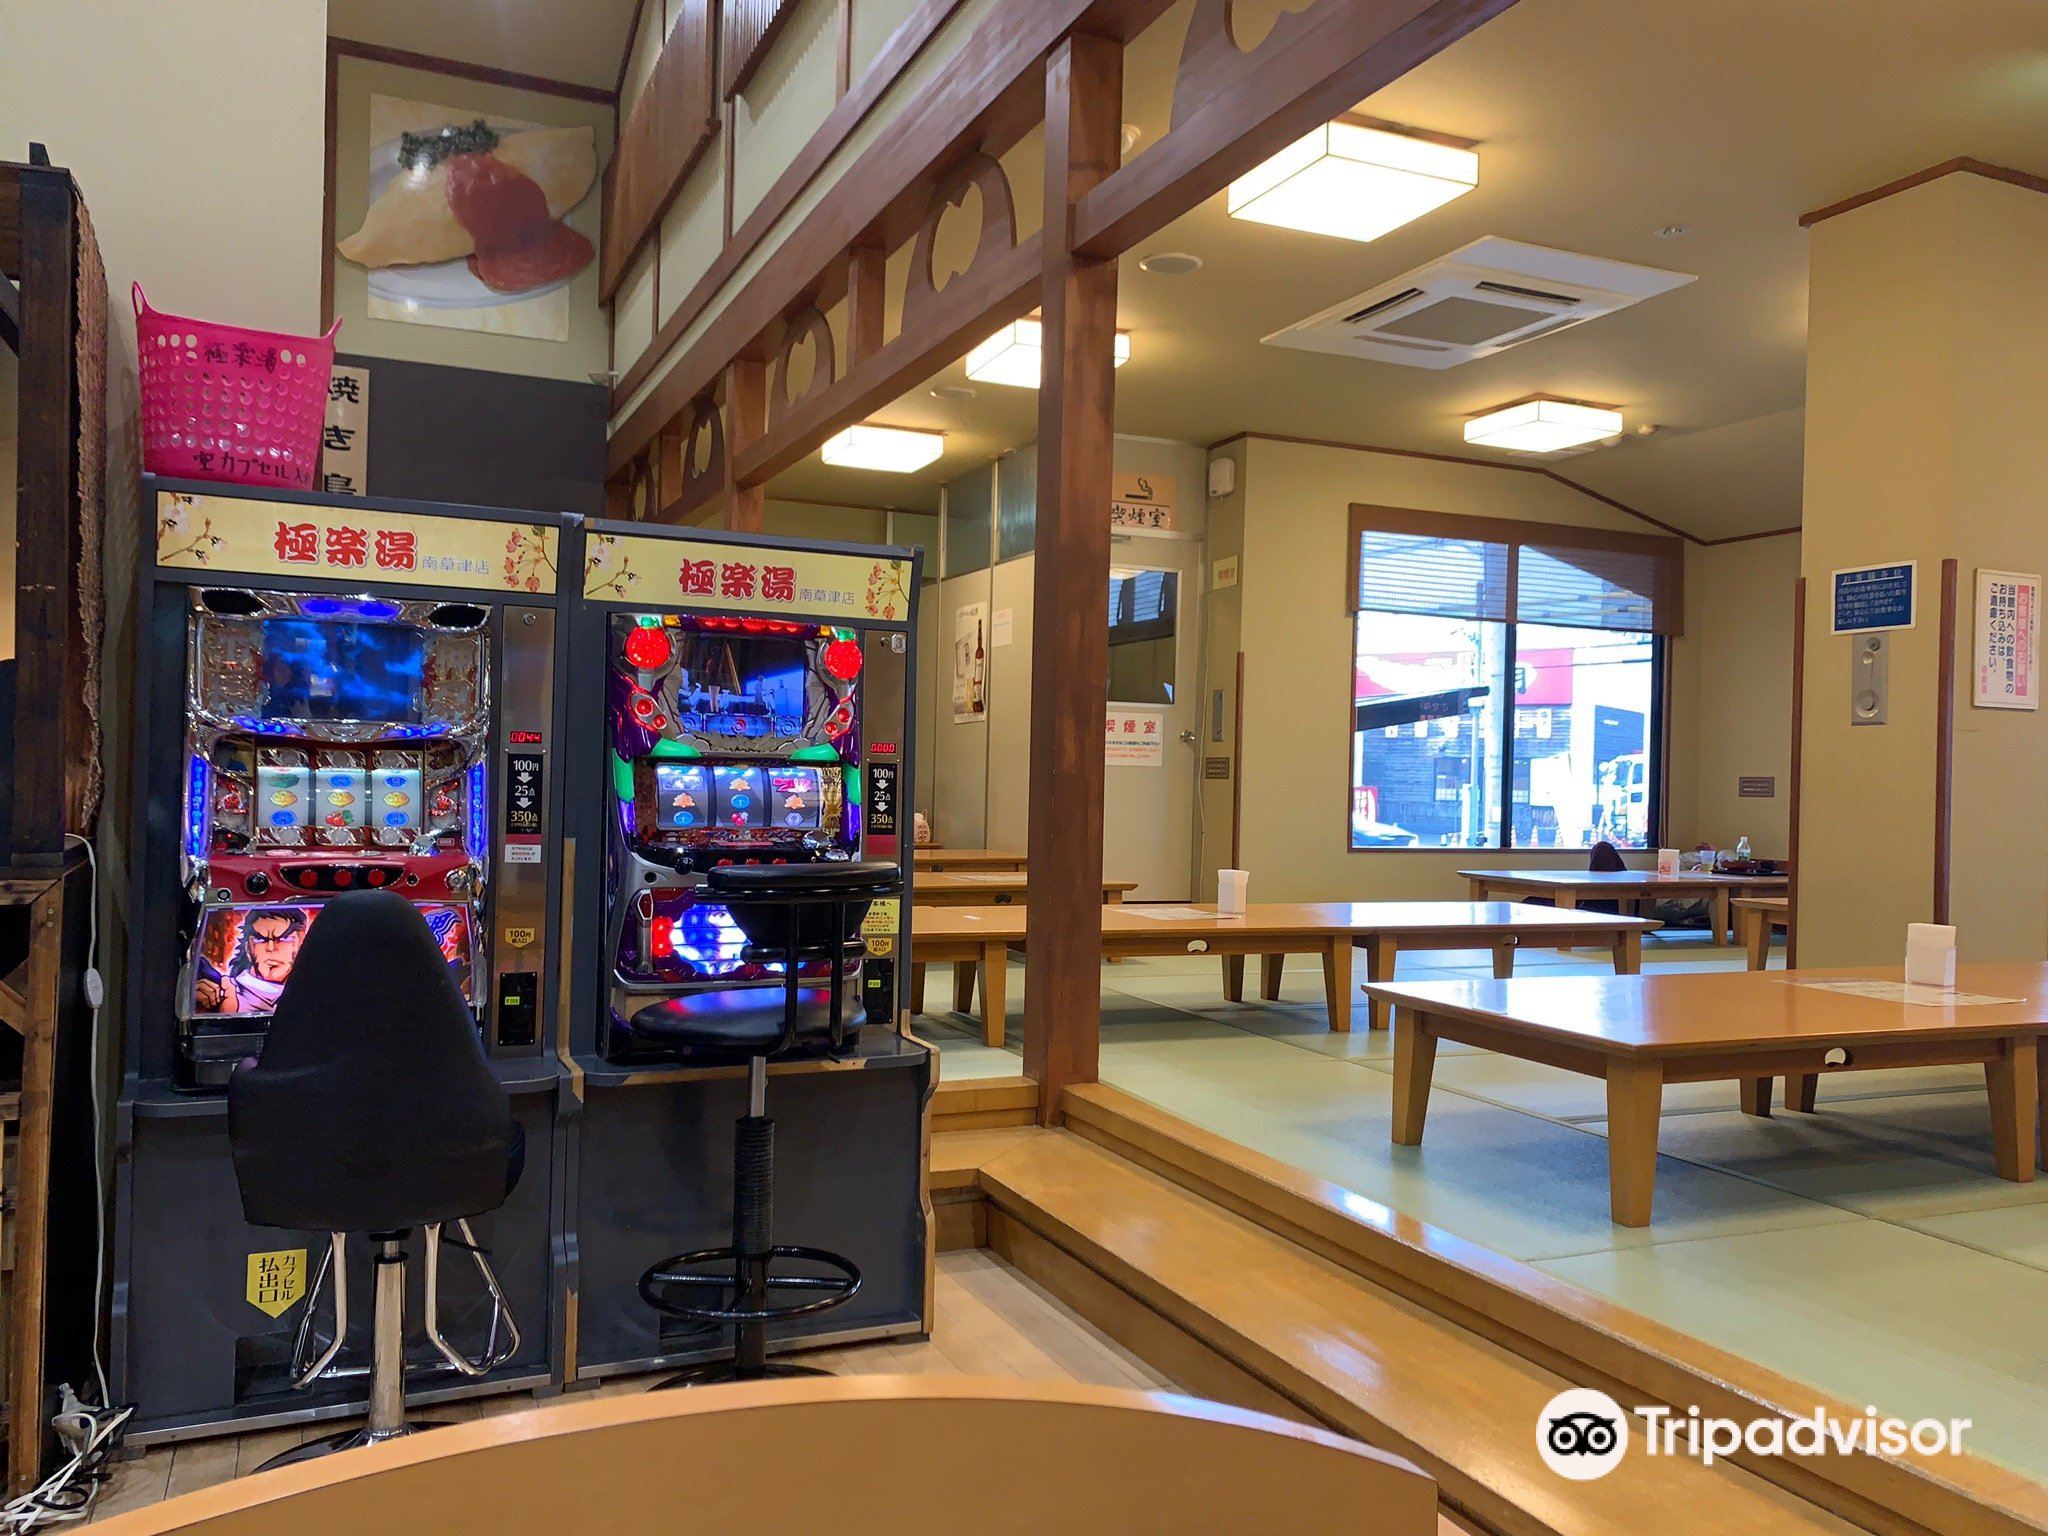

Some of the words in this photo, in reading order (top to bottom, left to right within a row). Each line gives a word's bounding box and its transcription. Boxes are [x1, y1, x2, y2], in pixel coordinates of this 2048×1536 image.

[204, 341, 278, 374] 極楽湯
[273, 521, 418, 571] 極楽湯
[421, 555, 490, 576] 南草津店
[678, 557, 797, 603] 極楽湯
[799, 587, 856, 606] 南草津店
[513, 759, 539, 772] 100円
[872, 768, 894, 779] 100円
[514, 785, 535, 797] 25点
[510, 810, 538, 823] 350点
[509, 930, 531, 939] 100円
[258, 1257, 280, 1304] 払出口
